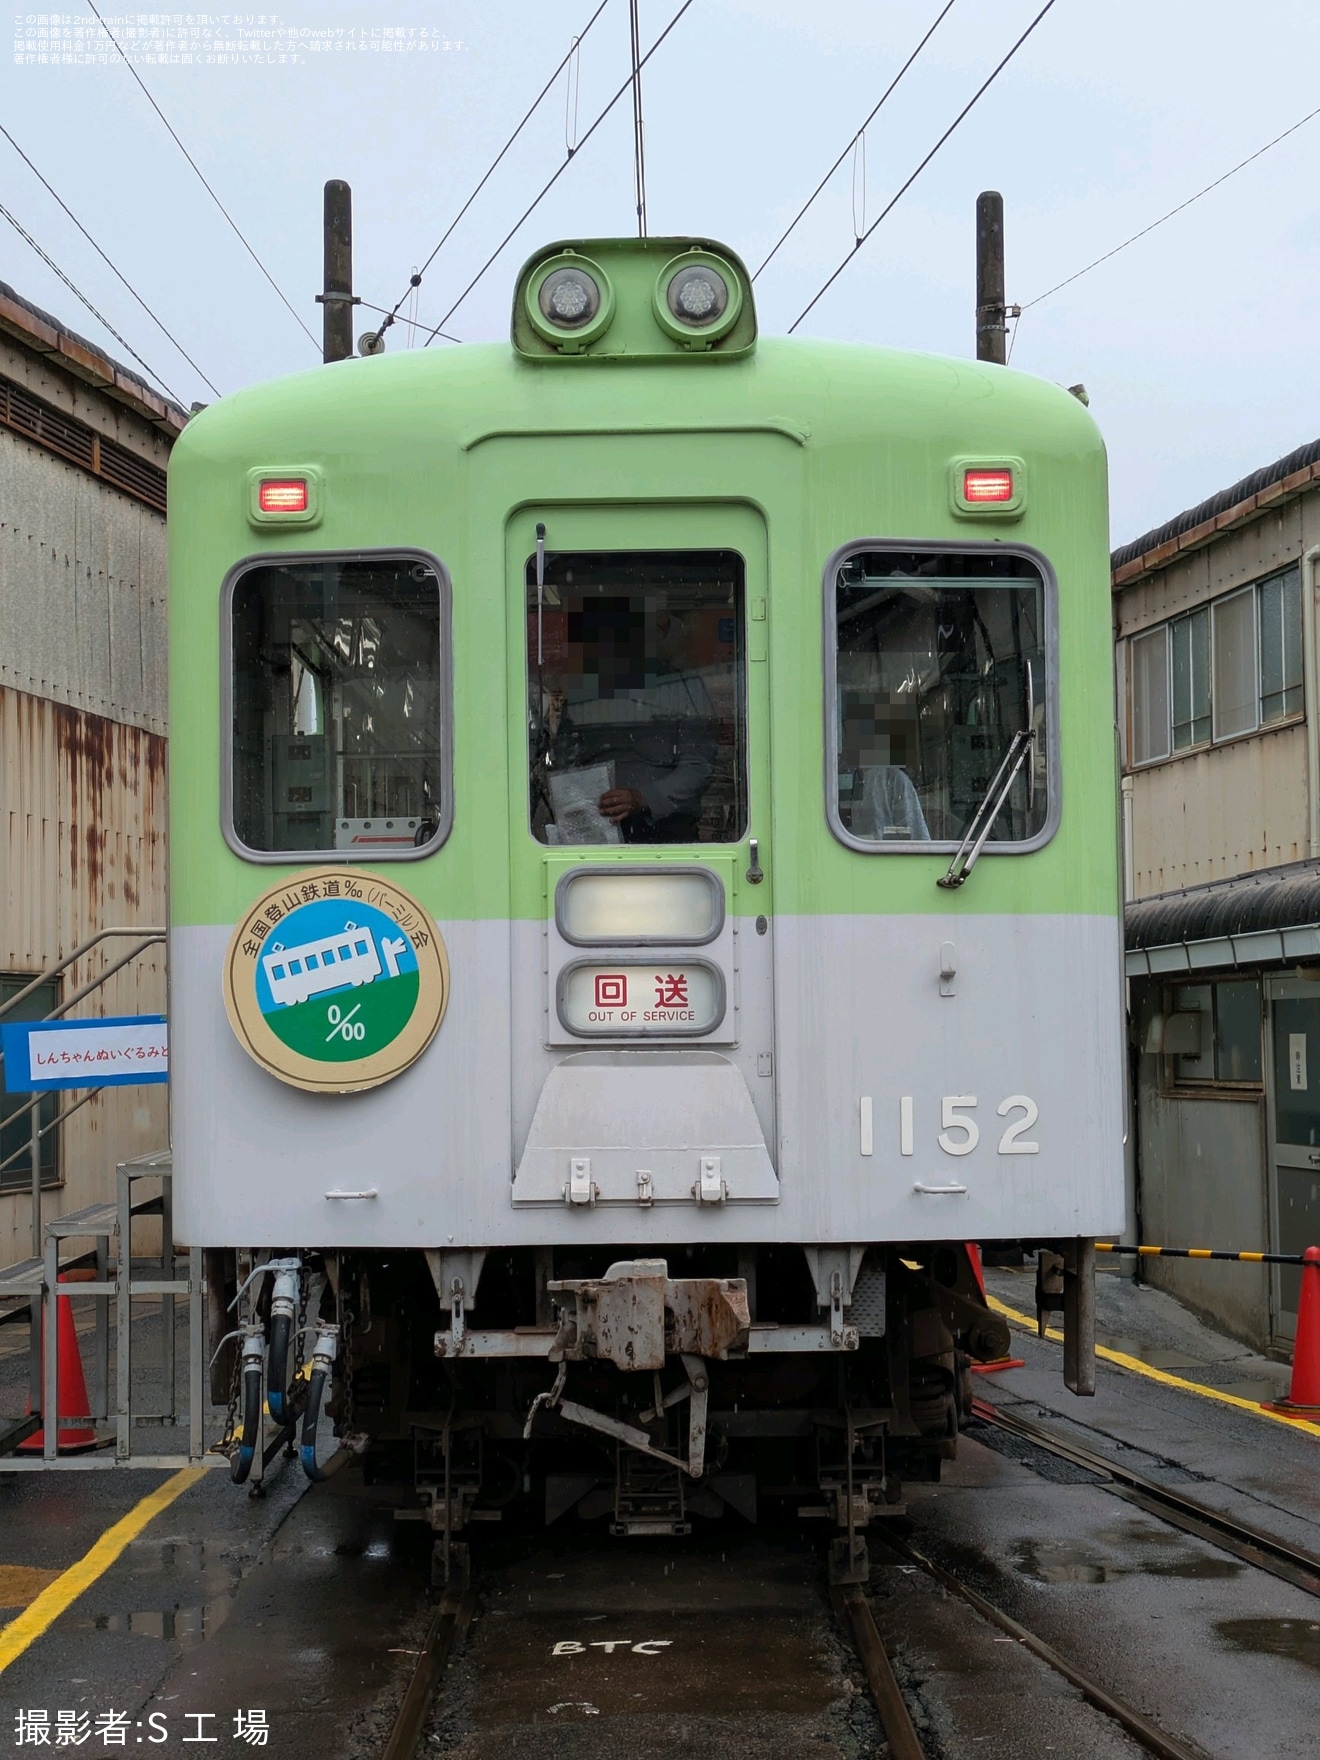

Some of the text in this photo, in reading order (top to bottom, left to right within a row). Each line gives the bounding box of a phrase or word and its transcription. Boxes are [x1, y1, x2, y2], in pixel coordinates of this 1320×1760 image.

[595, 974, 689, 1008] 回送
[588, 1010, 695, 1022] OUT OF SERVICE
[859, 1094, 1040, 1156] 1152
[552, 1640, 673, 1656] BTC
